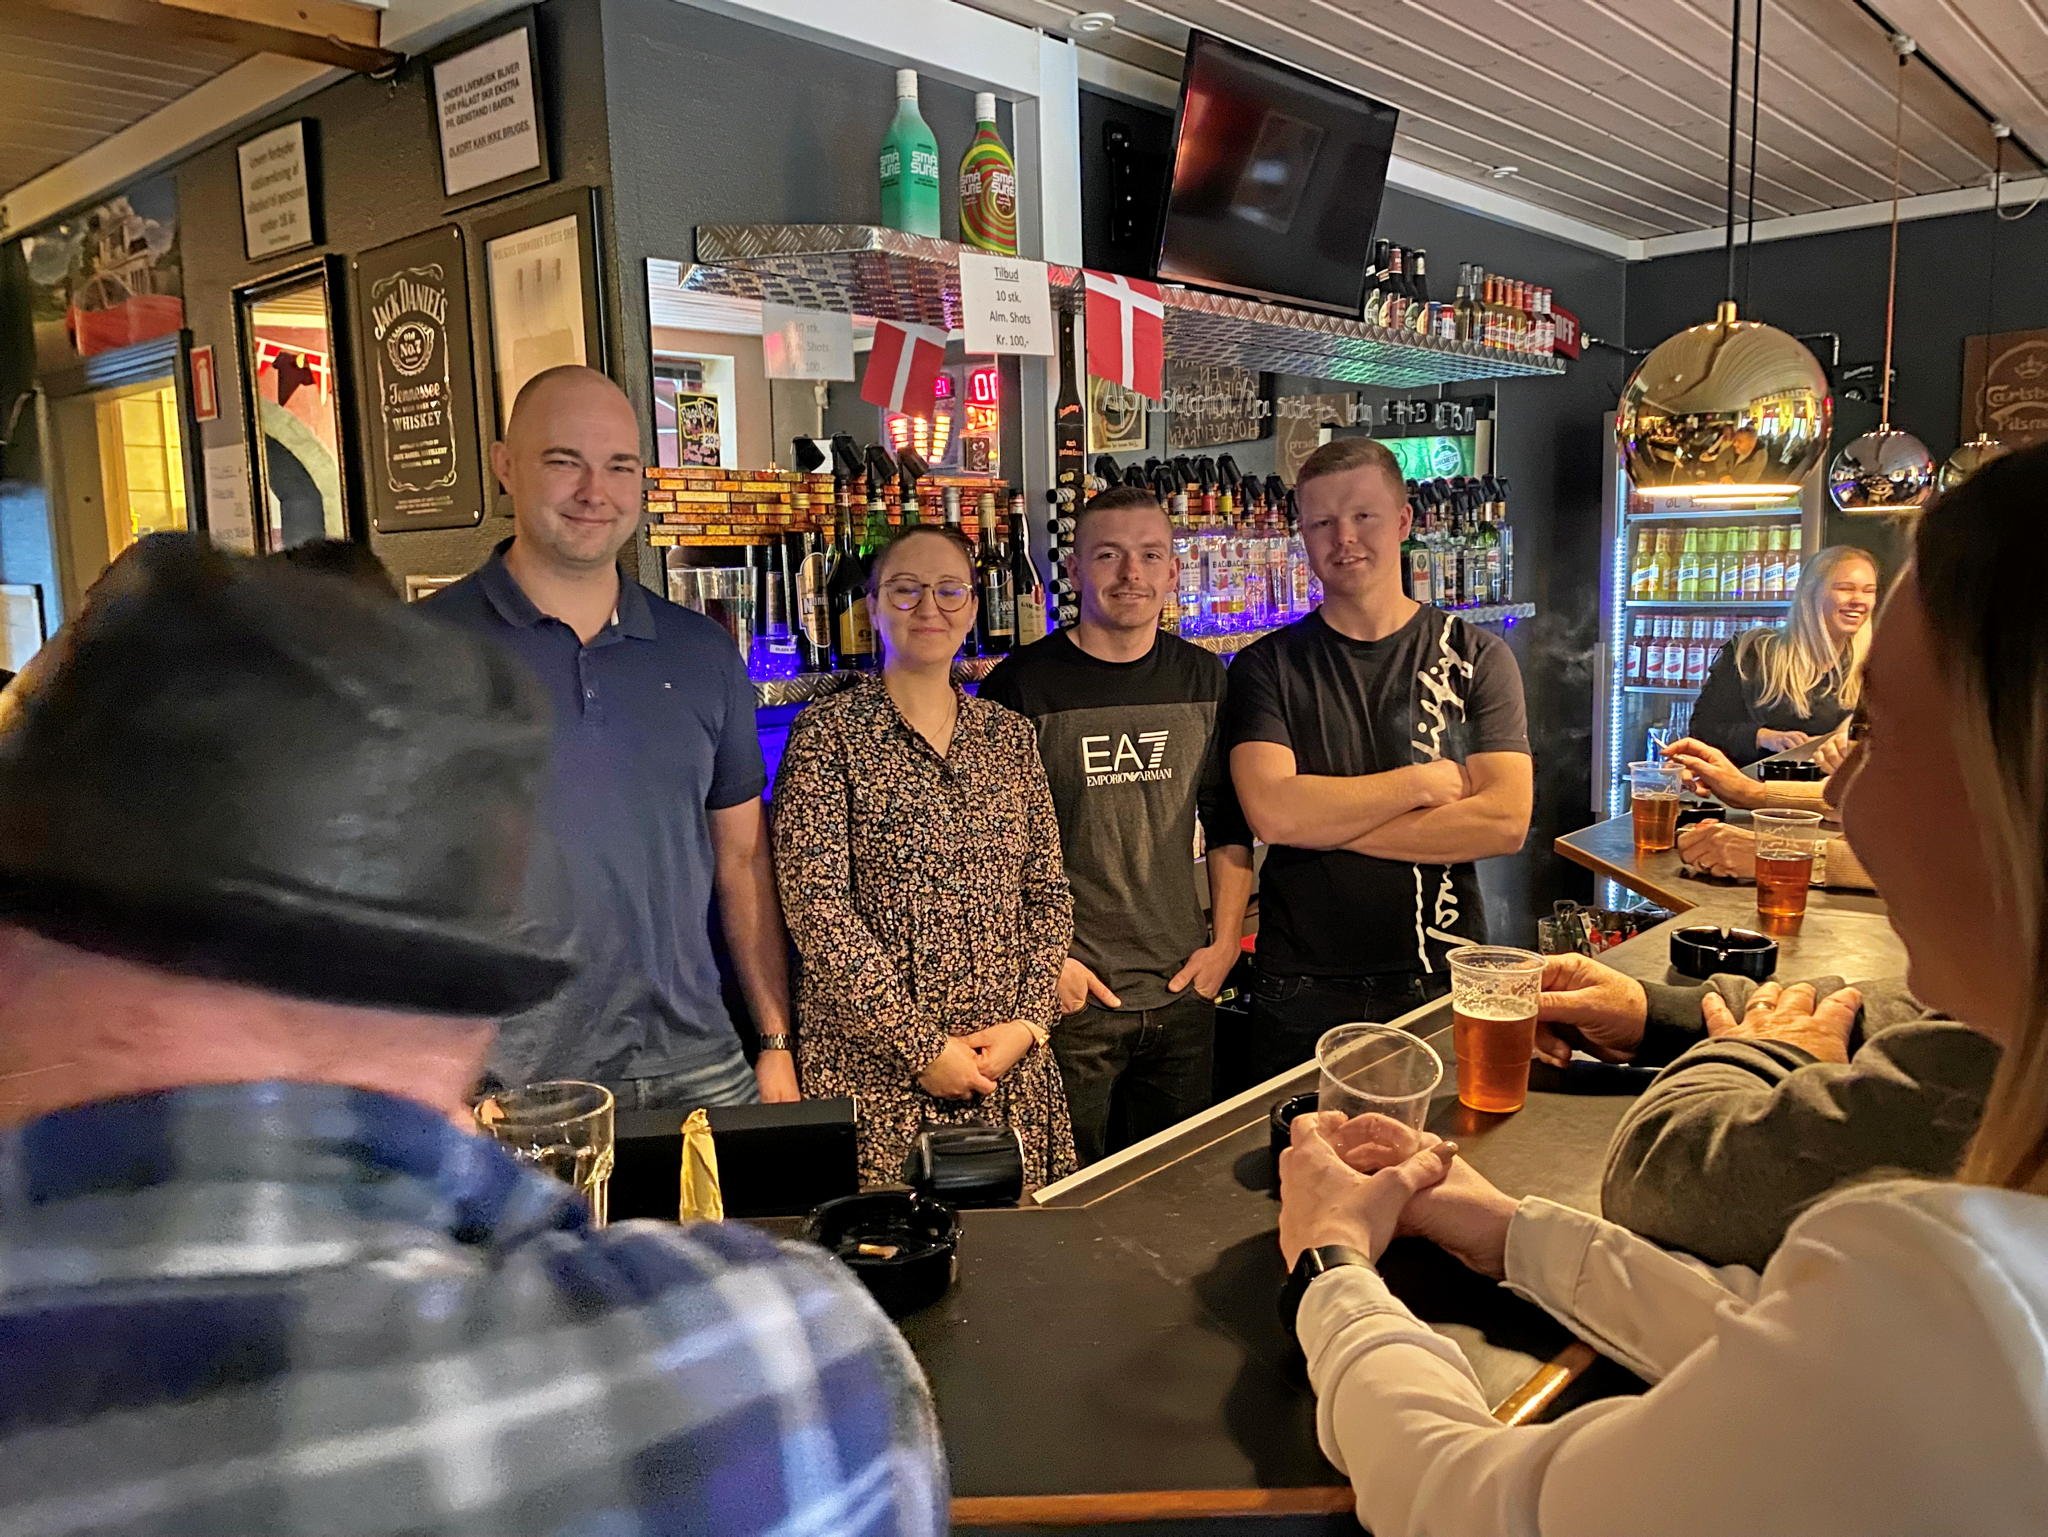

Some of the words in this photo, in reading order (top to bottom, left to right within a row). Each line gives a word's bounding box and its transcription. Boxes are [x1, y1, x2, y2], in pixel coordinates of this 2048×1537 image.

[443, 85, 463, 102] UNDER
[464, 72, 496, 93] LIVEMUSIK
[497, 62, 520, 79] BLIVER
[494, 77, 519, 95] EKSTRA
[456, 105, 488, 125] GENSTAND
[473, 136, 487, 150] KAN
[487, 130, 502, 144] IKKE
[994, 266, 1019, 280] Tilbud
[996, 290, 1006, 302] 10
[1008, 291, 1022, 303] stk.
[372, 290, 401, 340] JACK
[399, 278, 448, 325] DANIEL'S
[989, 310, 1008, 323] Alm.
[1010, 311, 1031, 324] Shots
[996, 334, 1008, 346] Kr.
[1010, 335, 1029, 348] 100,-
[389, 382, 441, 405] Tennessee
[1986, 384, 2048, 407] Carlsb
[393, 411, 441, 431] WHISKEY
[1082, 730, 1169, 773] EA7
[1087, 772, 1126, 787] EMPORIO
[1138, 768, 1173, 782] ARMANI
